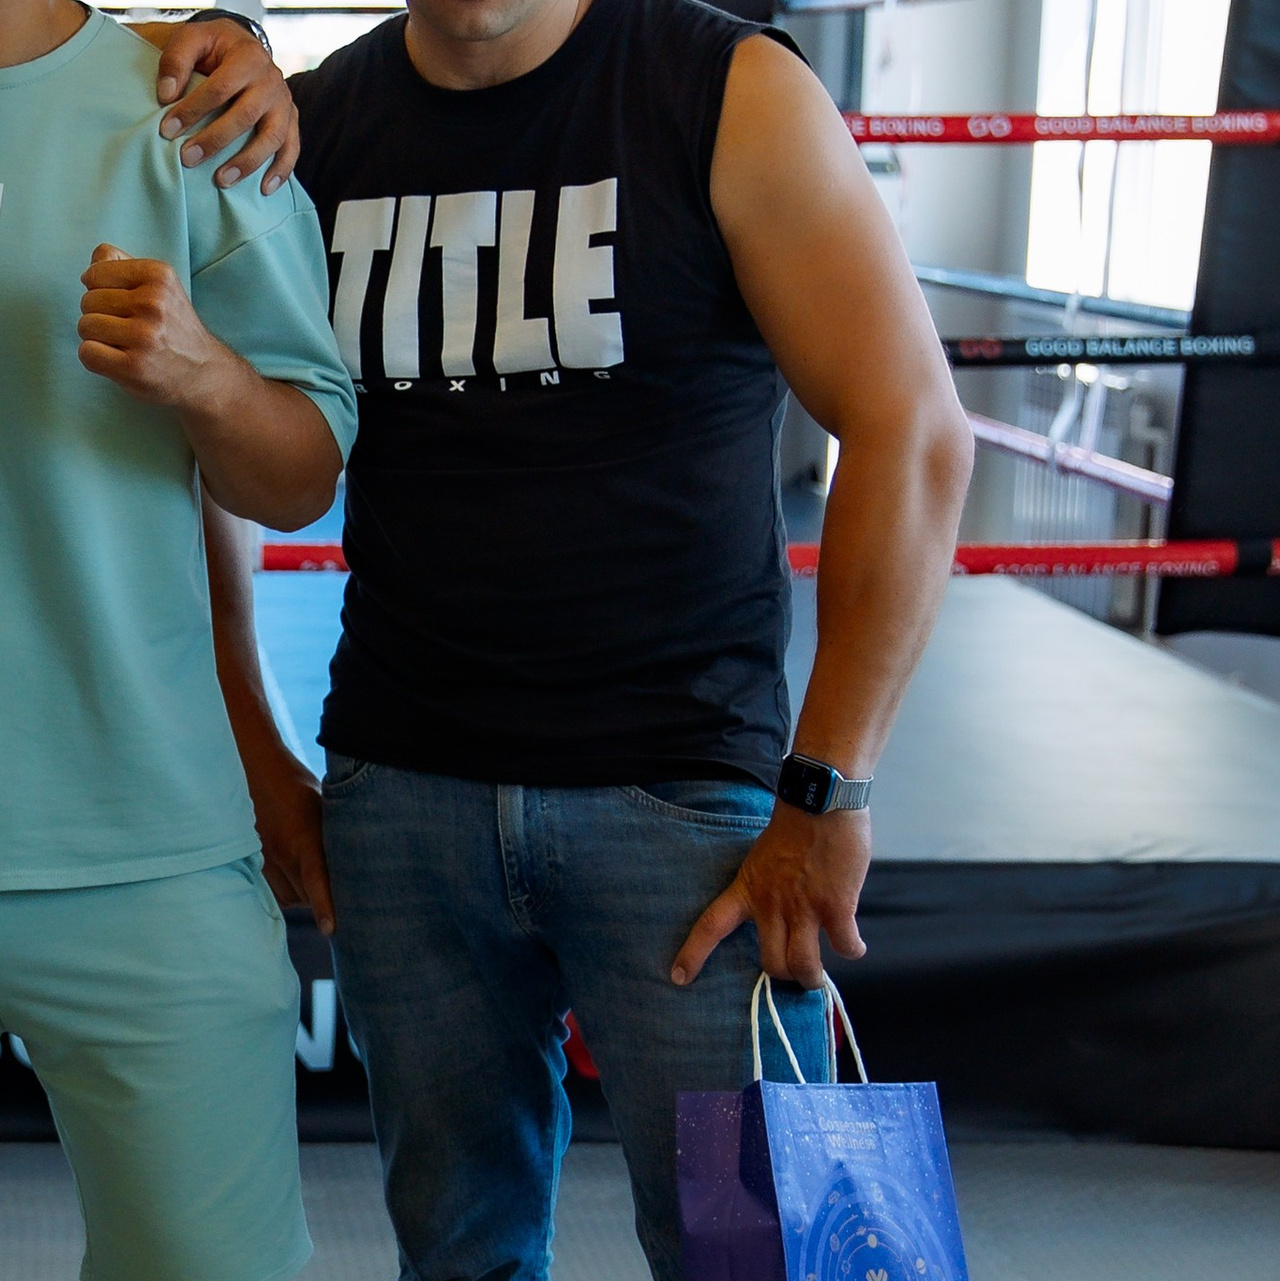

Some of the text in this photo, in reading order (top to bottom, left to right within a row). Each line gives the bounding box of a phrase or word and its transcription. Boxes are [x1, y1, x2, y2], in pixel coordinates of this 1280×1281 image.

[870, 117, 945, 137] BOXING
[1034, 117, 1094, 134] GOOD
[1096, 116, 1188, 134] BALANCE
[1191, 111, 1268, 133] BOXING
[330, 178, 624, 380] TITLE
[1025, 337, 1083, 356] GOOD
[1086, 337, 1178, 356] BALANCE
[1180, 335, 1256, 355] BOXING
